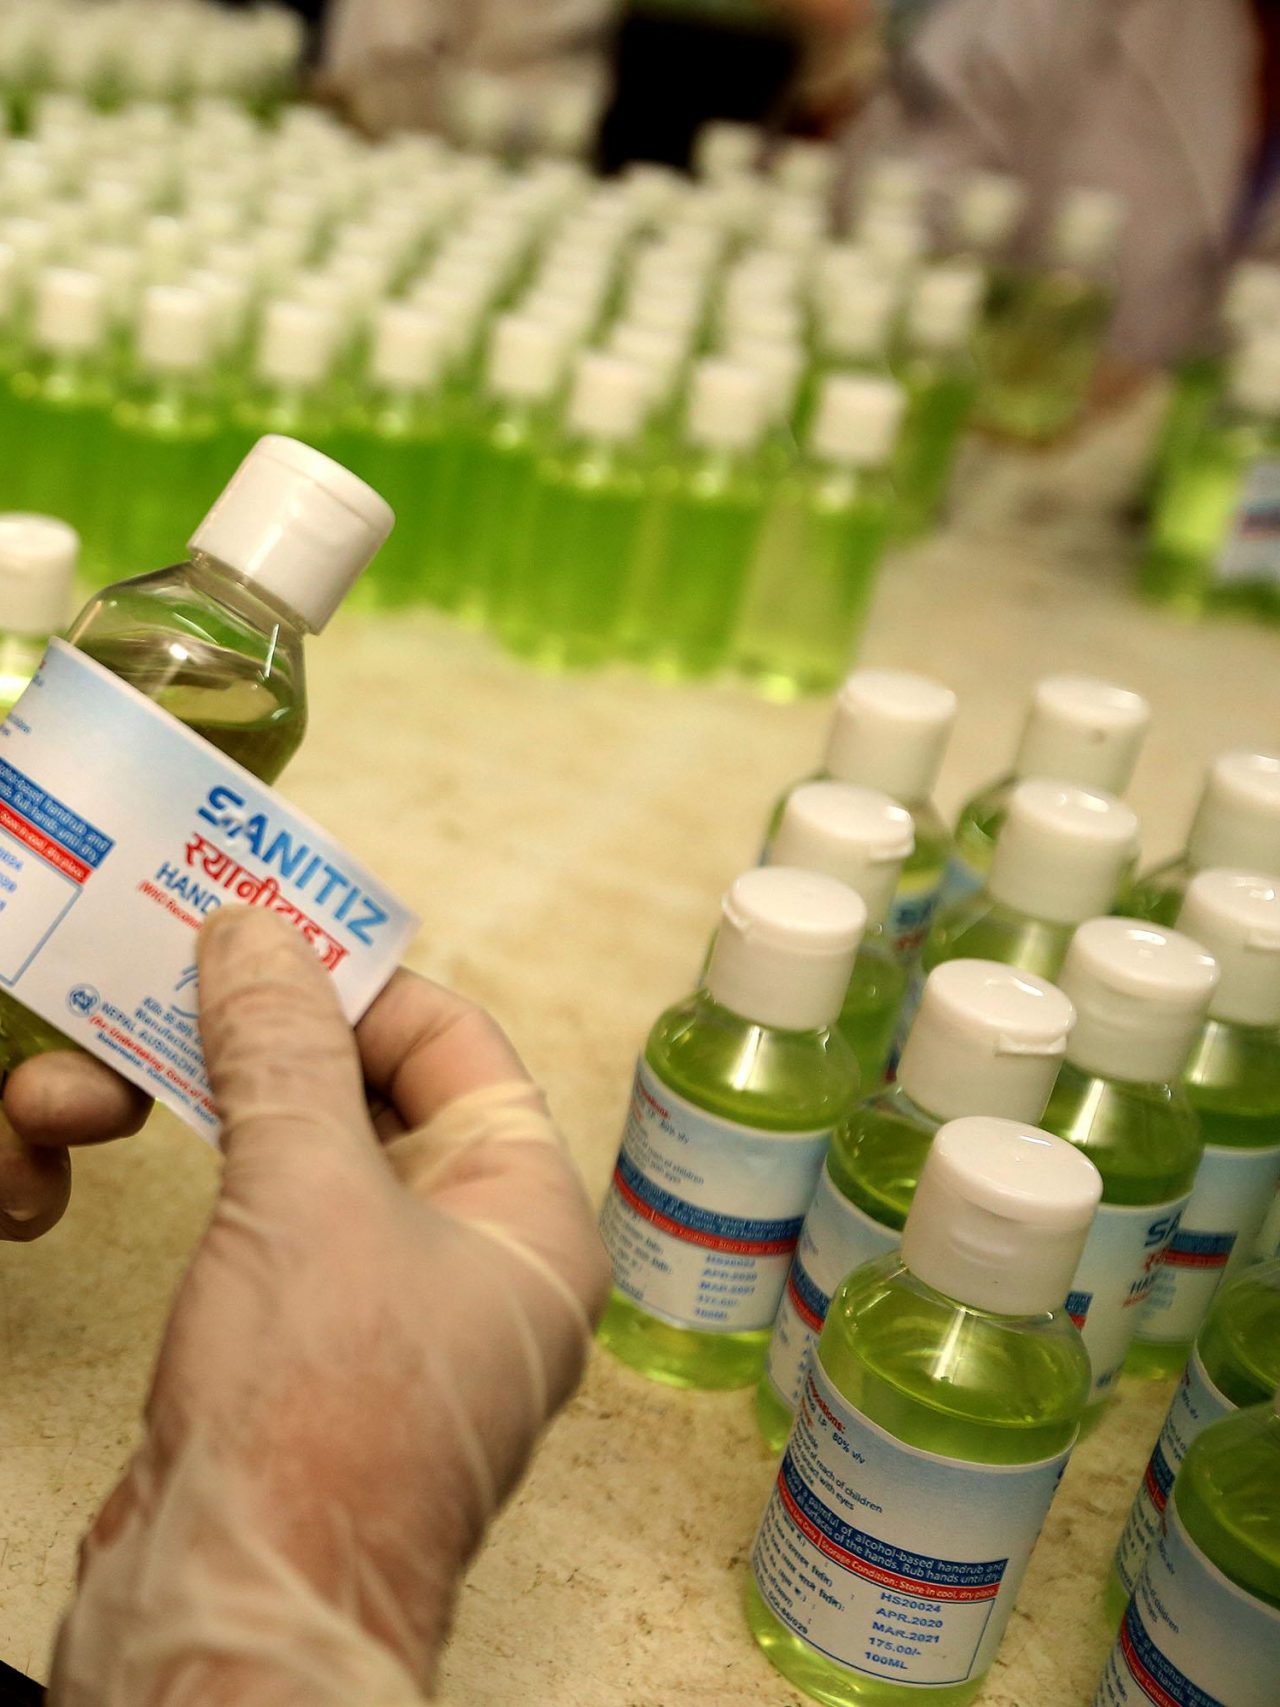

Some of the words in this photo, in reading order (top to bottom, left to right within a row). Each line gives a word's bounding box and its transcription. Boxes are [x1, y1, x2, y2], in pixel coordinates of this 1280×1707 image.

[197, 785, 389, 946] SANITIZ
[156, 863, 223, 916] HAND
[845, 1486, 883, 1513] children
[834, 1532, 846, 1545] of
[846, 1537, 863, 1553] the
[865, 1548, 899, 1571] hands.
[903, 1562, 924, 1577] Rub
[927, 1570, 959, 1584] hands
[960, 1573, 983, 1584] until
[842, 1525, 854, 1538] of
[855, 1532, 933, 1569] alcohol-based
[938, 1561, 984, 1575] handrub
[821, 1541, 851, 1565] Storage
[851, 1560, 898, 1586] Condition:
[899, 1581, 926, 1594] Store
[880, 1592, 941, 1613] HS20024
[875, 1607, 943, 1629] APR.2020
[872, 1621, 940, 1643] MAR.2021
[868, 1637, 922, 1656] 175.00/-
[864, 1651, 908, 1670] 100ML
